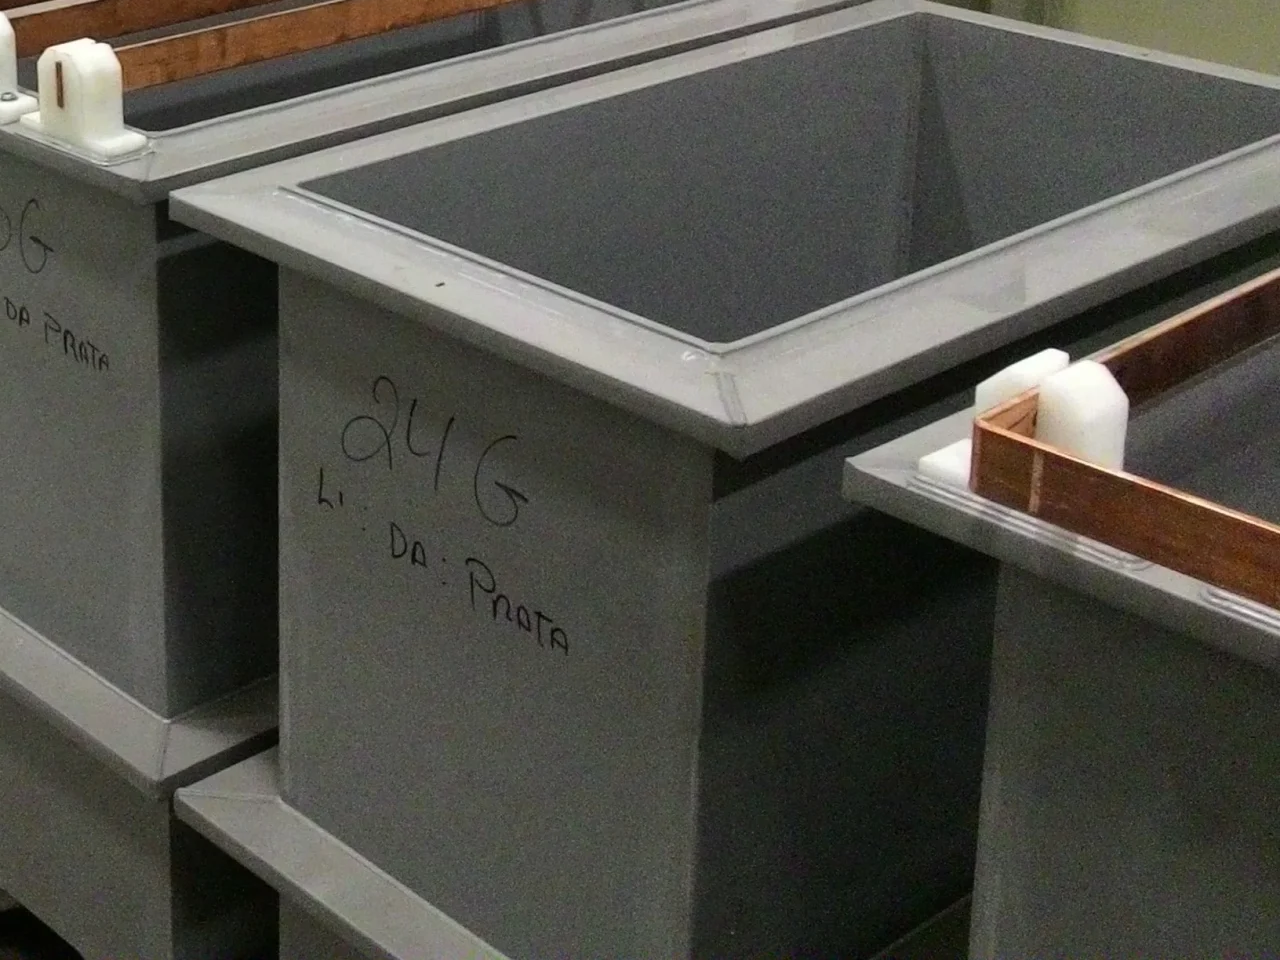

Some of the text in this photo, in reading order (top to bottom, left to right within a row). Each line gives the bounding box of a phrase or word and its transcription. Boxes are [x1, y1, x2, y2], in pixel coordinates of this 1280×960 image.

[3, 295, 31, 327] DA
[43, 311, 110, 372] PRATA
[465, 557, 569, 657] PRATA
